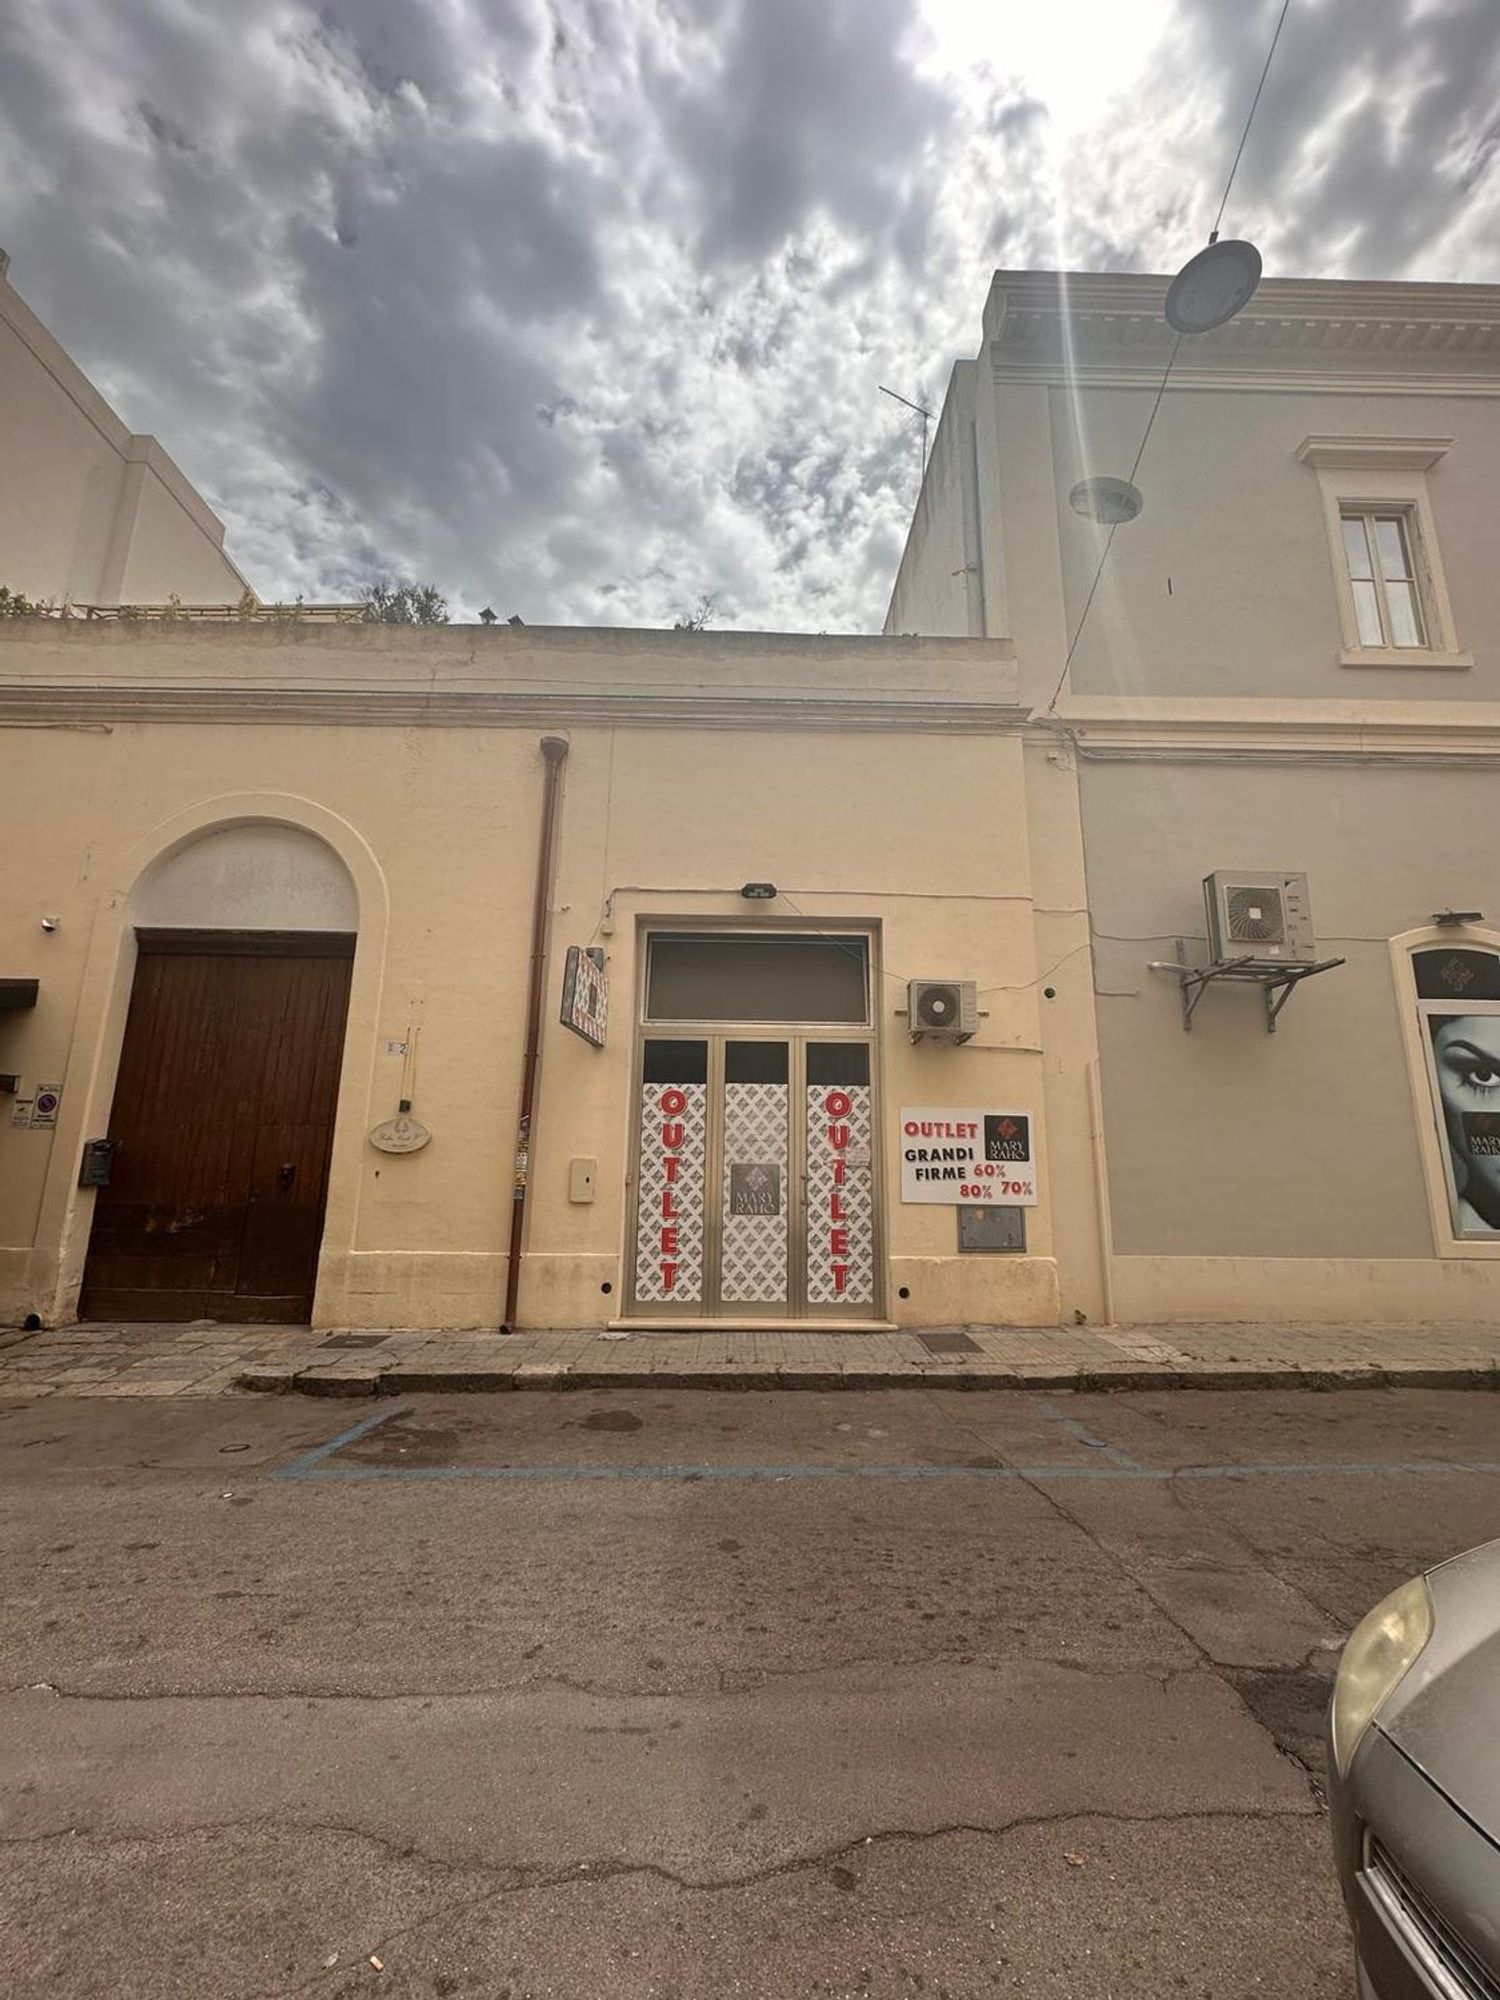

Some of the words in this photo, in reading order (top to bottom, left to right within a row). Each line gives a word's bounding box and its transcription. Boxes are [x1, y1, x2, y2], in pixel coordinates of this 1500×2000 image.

[904, 1121, 978, 1139] OUTLET
[904, 1147, 974, 1162] GRANDI
[990, 1140, 1024, 1151] MARY
[991, 1149, 1026, 1160] RAHO
[915, 1166, 967, 1181] FIRME
[973, 1163, 1006, 1178] 60%
[661, 1090, 687, 1292] OUTLET
[736, 1191, 772, 1203] MARY
[825, 1092, 852, 1294] OUTLET
[960, 1184, 993, 1199] 80%
[1001, 1180, 1033, 1196] 70%
